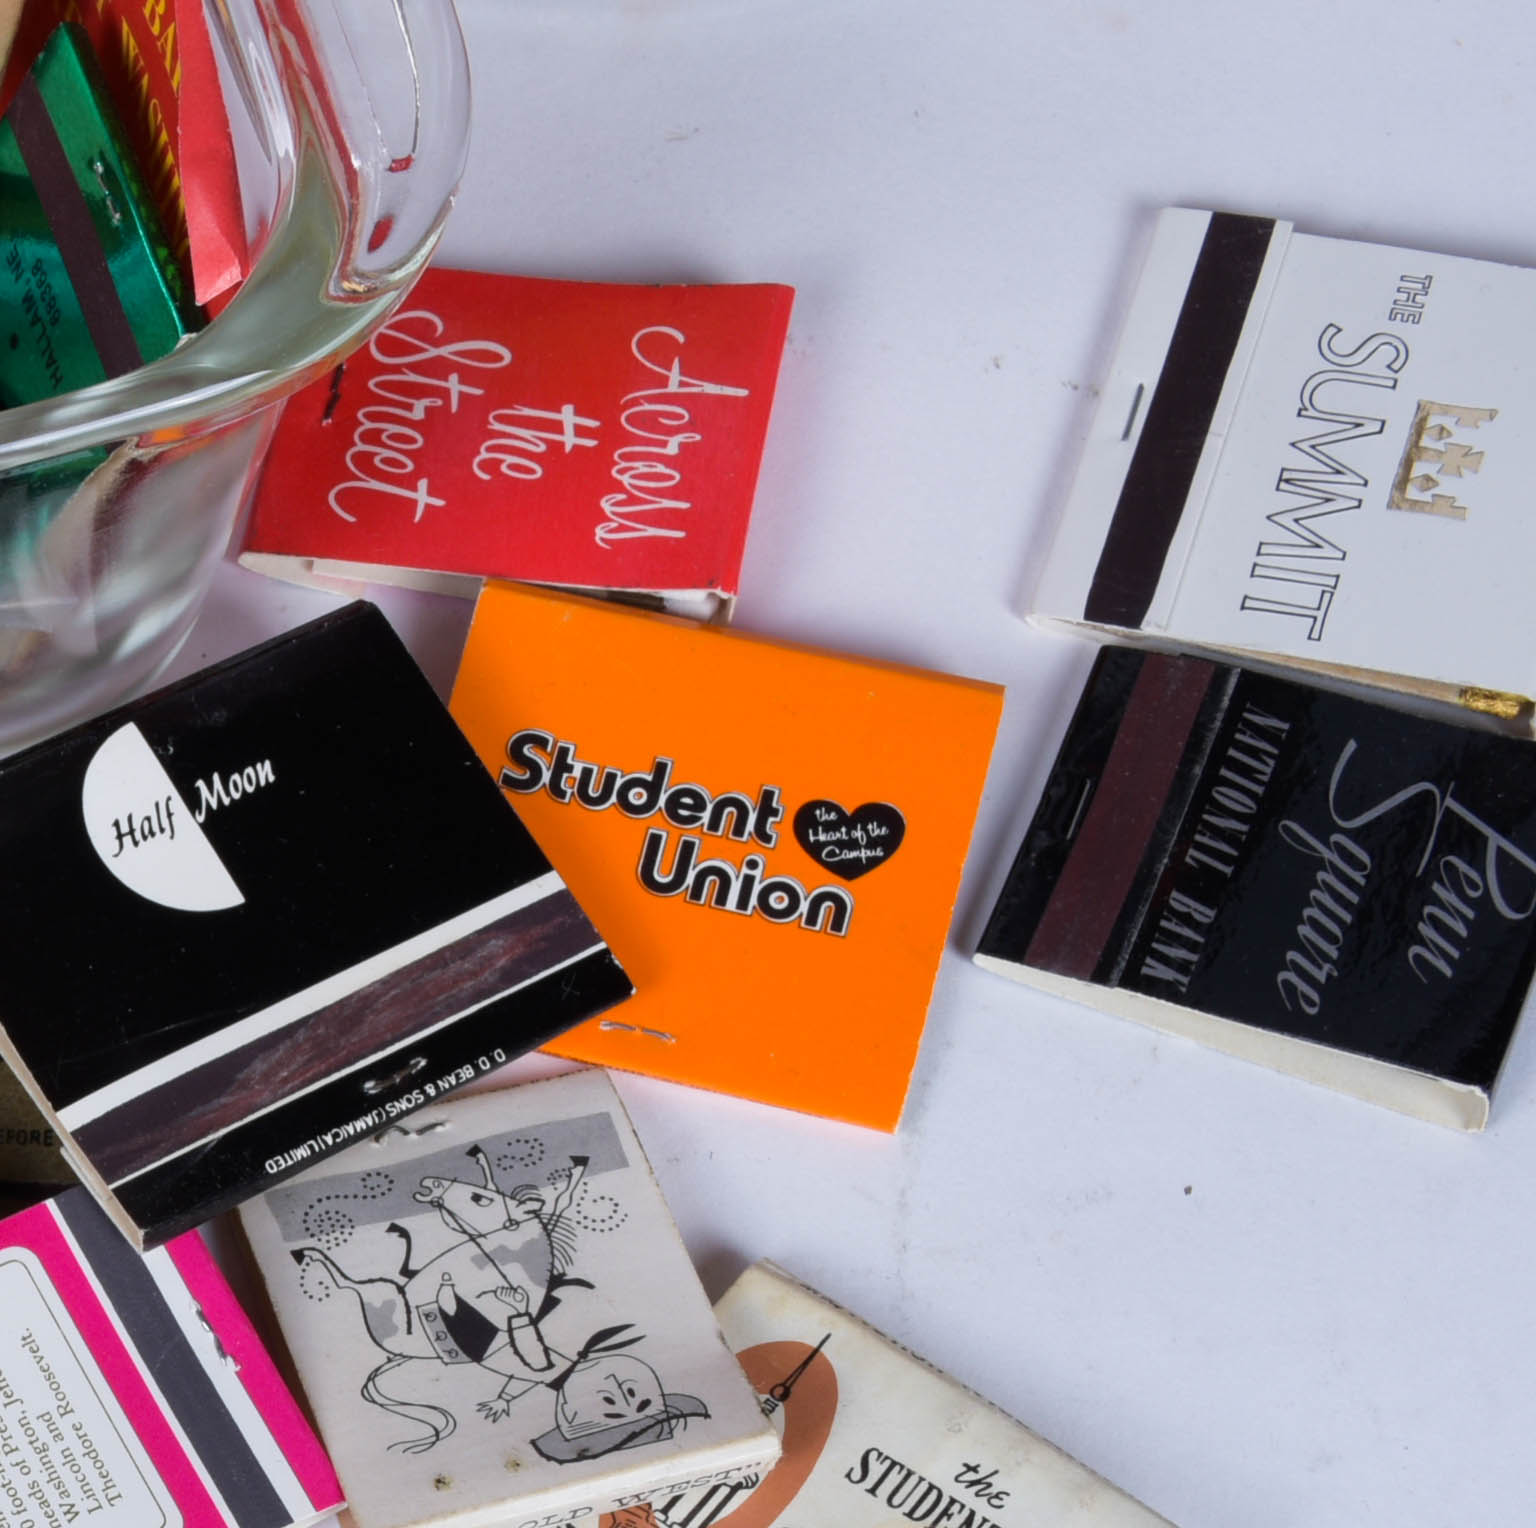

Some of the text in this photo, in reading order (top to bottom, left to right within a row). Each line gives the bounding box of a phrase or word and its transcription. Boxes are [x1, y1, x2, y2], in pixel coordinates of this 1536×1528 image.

[1388, 275, 1433, 325] THE
[328, 309, 512, 524] Street
[472, 404, 600, 481] the
[595, 326, 749, 549] Across
[1240, 323, 1409, 641] SUMMIT
[112, 759, 277, 859] Half Moon
[498, 728, 785, 848] Student
[809, 822, 889, 843] Heart the
[815, 807, 837, 822] the
[636, 827, 855, 938] Union
[822, 844, 883, 863] Campus
[1141, 703, 1290, 993] NATIONAL BANK
[1277, 739, 1448, 1016] Square
[1409, 782, 1536, 984] Penn
[70, 1420, 125, 1508] Theodore
[953, 1461, 1012, 1511] the
